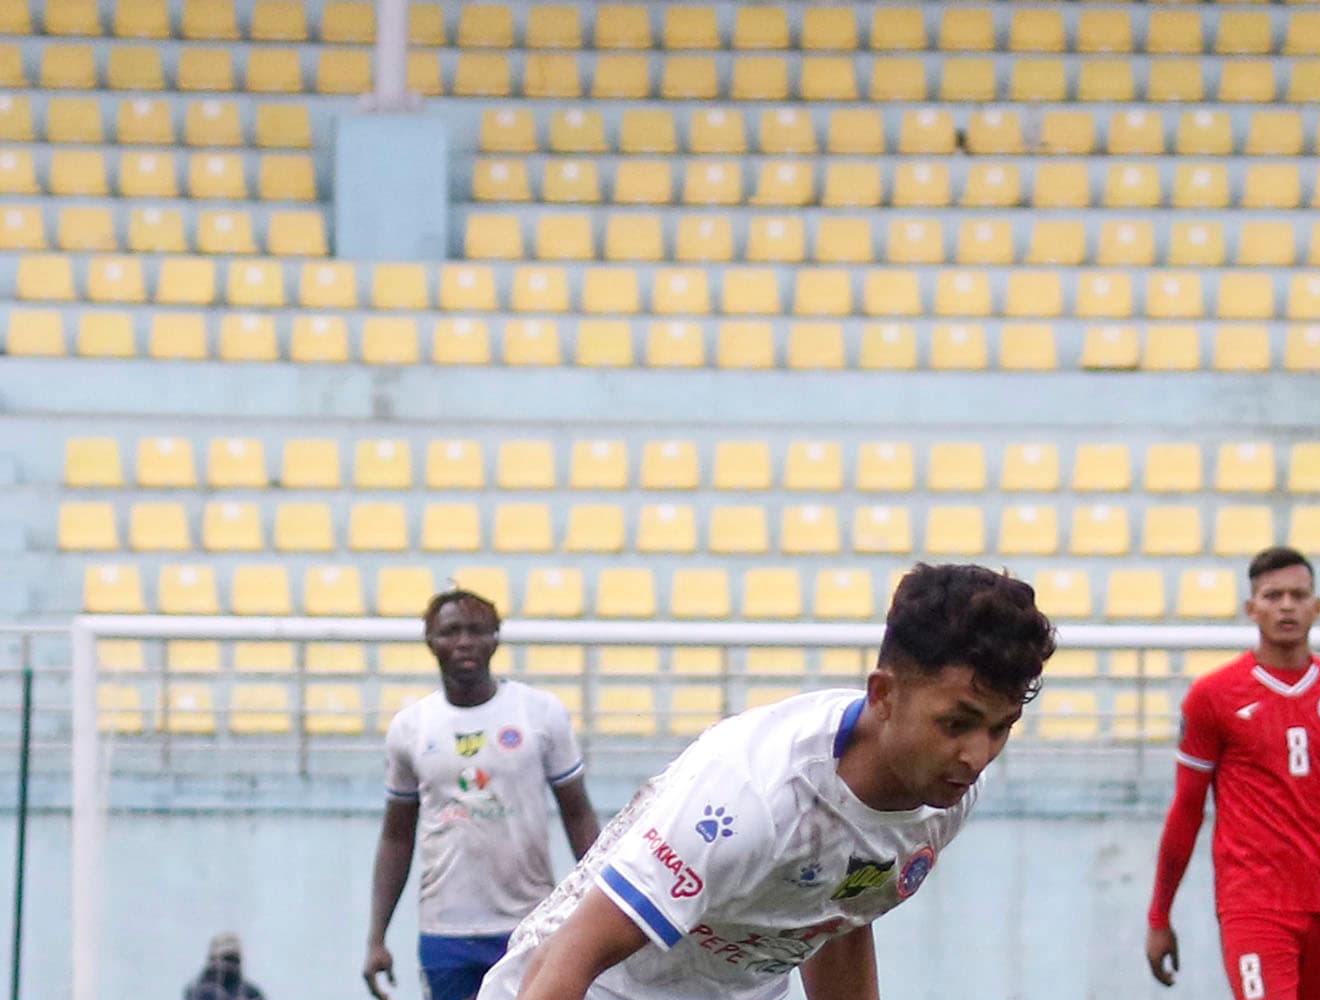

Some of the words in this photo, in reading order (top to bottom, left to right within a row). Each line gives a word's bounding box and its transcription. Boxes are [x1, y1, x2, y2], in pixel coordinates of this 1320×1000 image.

[1286, 726, 1310, 777] 8
[642, 827, 684, 876] POKKA
[689, 923, 747, 964] PEPE
[1239, 953, 1264, 1000] 8
